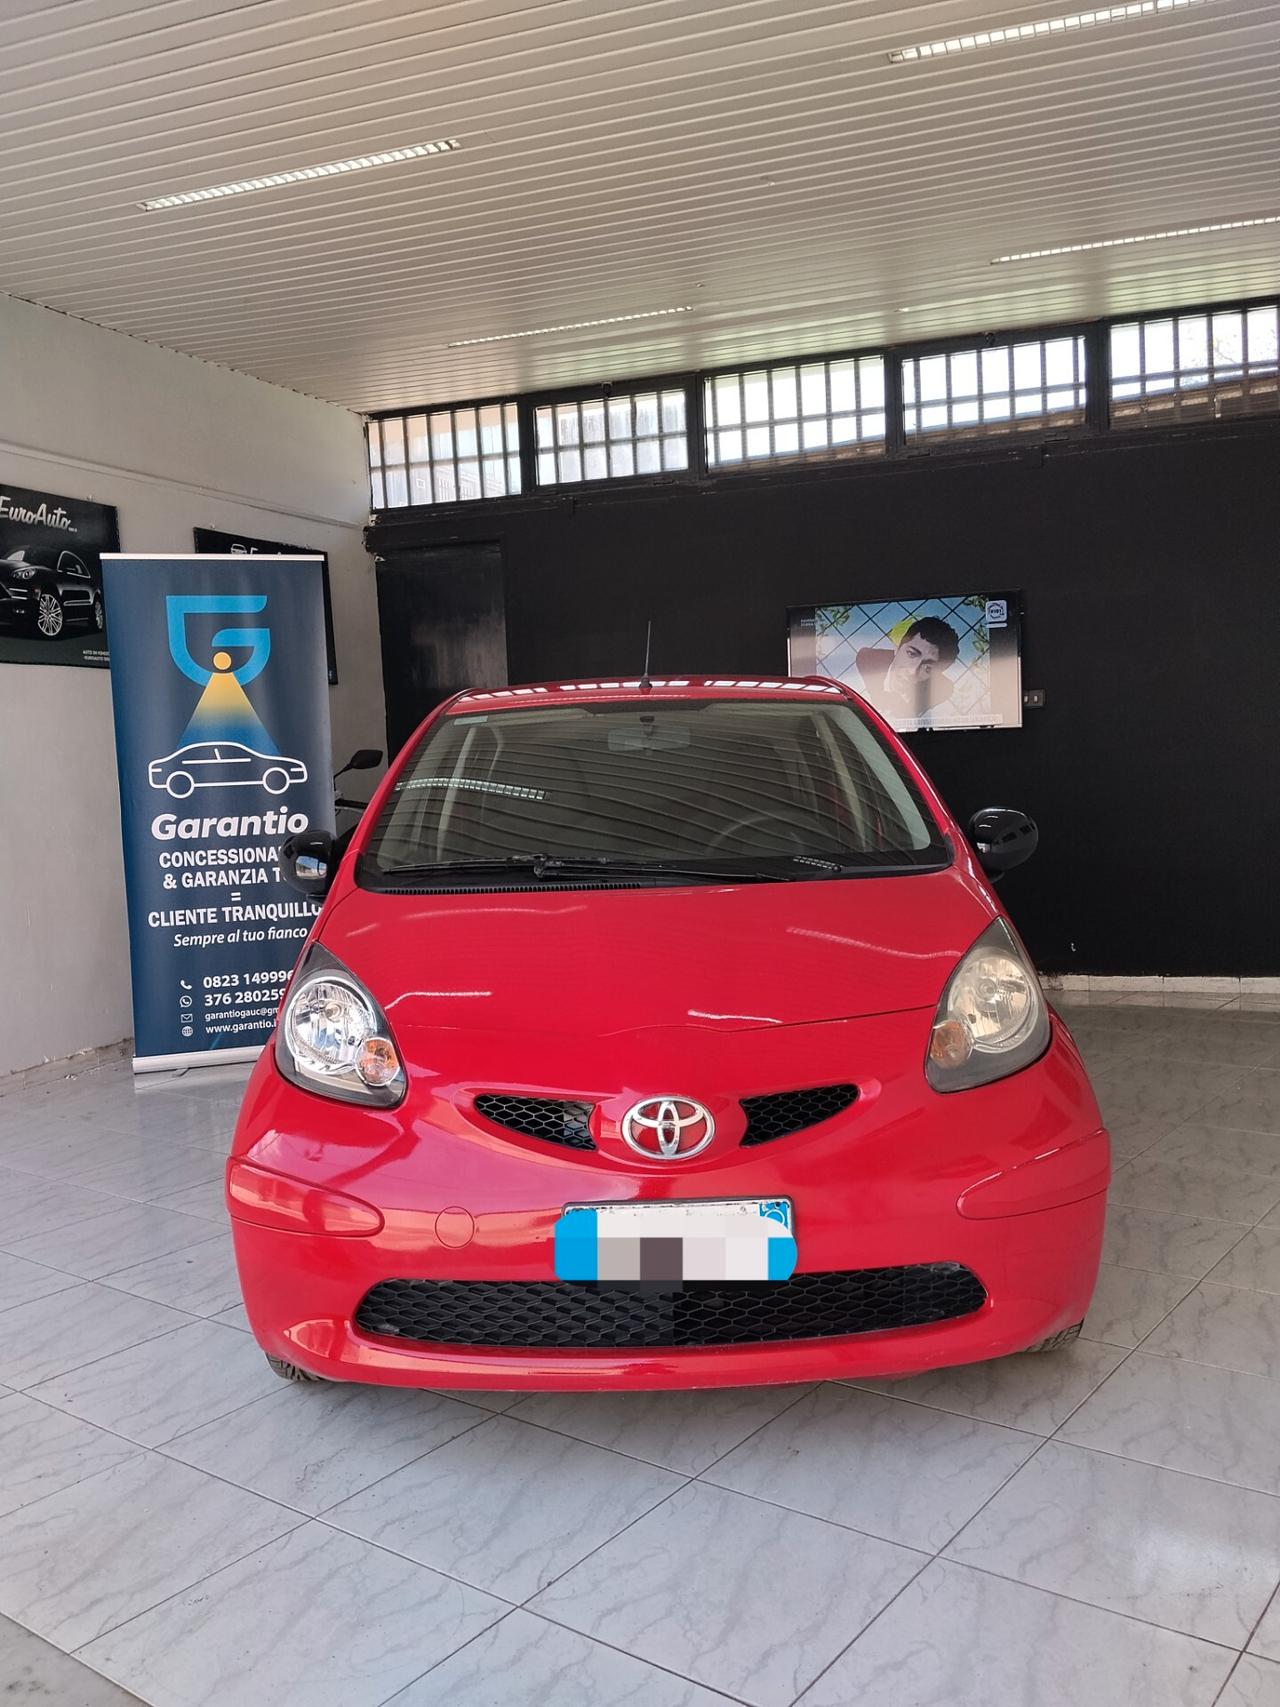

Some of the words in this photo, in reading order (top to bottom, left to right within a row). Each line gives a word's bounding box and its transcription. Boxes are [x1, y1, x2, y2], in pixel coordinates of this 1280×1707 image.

[151, 806, 309, 841] Garantio
[158, 846, 281, 868] CONCESSIONA
[163, 874, 177, 889] &
[181, 868, 269, 889] GARANZIA
[148, 908, 217, 928] CLIENTE
[173, 932, 225, 948] Sempre
[227, 928, 240, 944] al
[242, 930, 265, 942] tuo
[267, 926, 308, 940] fianco
[203, 974, 239, 989] 0823
[204, 993, 232, 1006] 376
